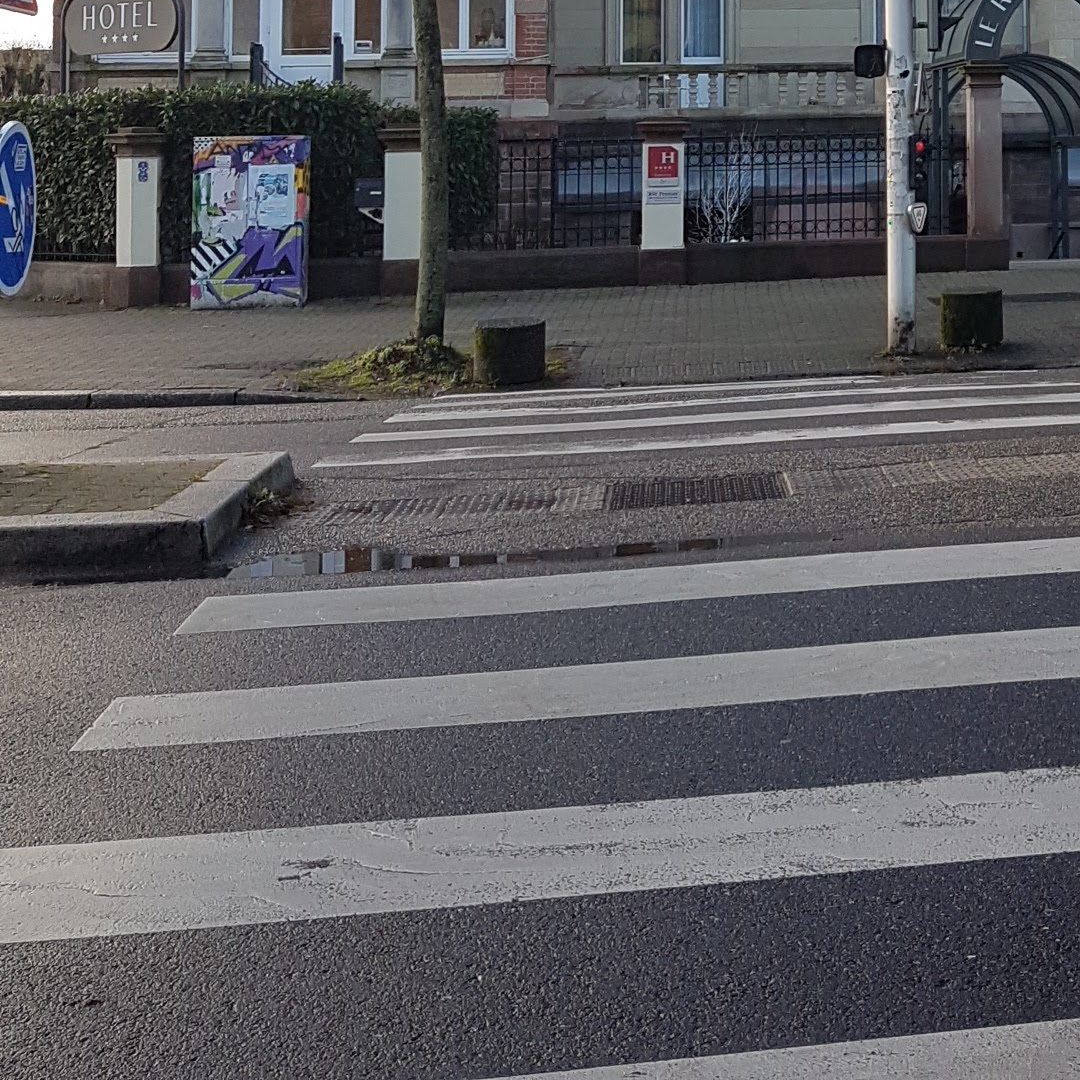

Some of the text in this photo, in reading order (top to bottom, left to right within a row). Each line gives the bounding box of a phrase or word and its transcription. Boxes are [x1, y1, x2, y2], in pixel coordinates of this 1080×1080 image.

[82, 1, 158, 31] HOTEL
[974, 16, 999, 48] LE
[661, 152, 675, 164] H
